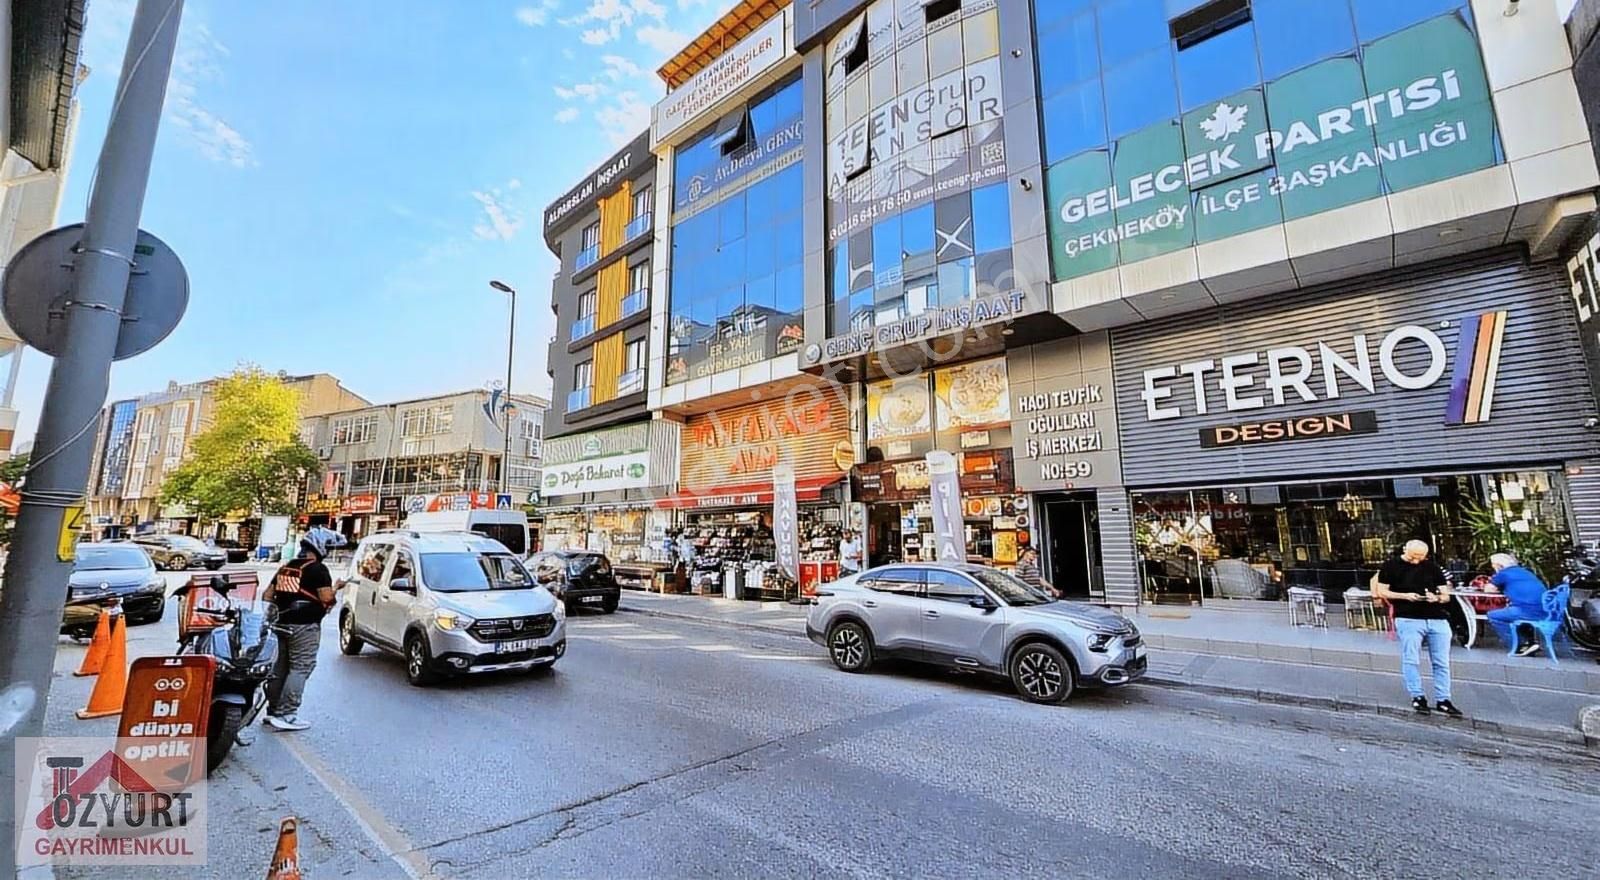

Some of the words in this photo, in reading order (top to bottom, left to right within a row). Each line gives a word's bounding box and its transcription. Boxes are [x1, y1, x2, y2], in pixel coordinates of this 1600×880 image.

[1060, 142, 1241, 223] GELECEK
[1064, 204, 1188, 257] ÇEKMEKÖY
[1201, 183, 1260, 216] İLÇE
[1268, 120, 1467, 197] BAŞKANLIĞI
[860, 205, 879, 223] 641
[881, 196, 895, 213] 78
[877, 318, 931, 344] GRUP
[1141, 325, 1447, 422] ETERNO
[1019, 393, 1049, 412] HACI
[1052, 384, 1102, 408] TEVFİK
[1028, 411, 1094, 433] OĞULLARI
[1215, 414, 1351, 444] DESIGN
[729, 444, 778, 473] AVM
[1025, 438, 1039, 460] İŞ
[1042, 430, 1101, 455] MERKEZİ
[1041, 461, 1091, 480] NO:59
[153, 699, 179, 718] bi
[130, 721, 193, 738] dünya
[124, 741, 191, 761] optik
